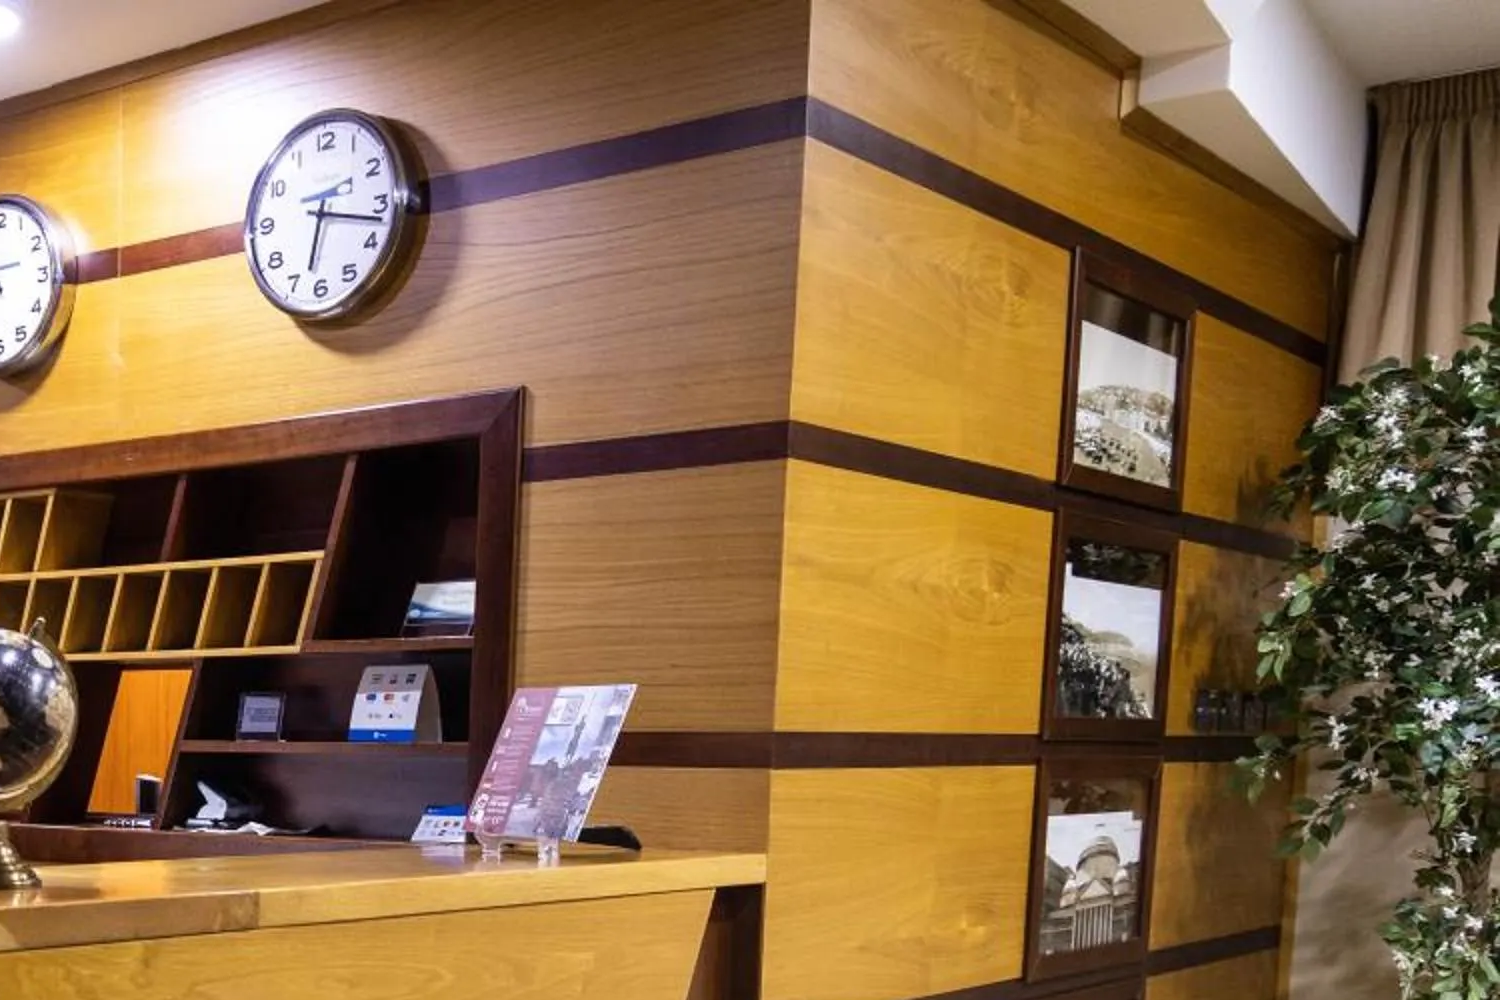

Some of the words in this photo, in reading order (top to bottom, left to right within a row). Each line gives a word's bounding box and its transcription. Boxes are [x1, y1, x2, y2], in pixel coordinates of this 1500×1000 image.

[317, 132, 335, 152] 12
[366, 158, 380, 177] 2
[270, 179, 285, 198] 10
[373, 194, 388, 214] 3
[259, 218, 274, 235] 9
[31, 236, 41, 252] 2
[364, 232, 378, 249] 4
[267, 251, 284, 269] 8
[37, 268, 48, 283] 3
[341, 264, 357, 282] 5
[288, 275, 300, 293] 7
[314, 279, 328, 297] 6
[31, 299, 41, 313] 4
[15, 325, 27, 342] 5
